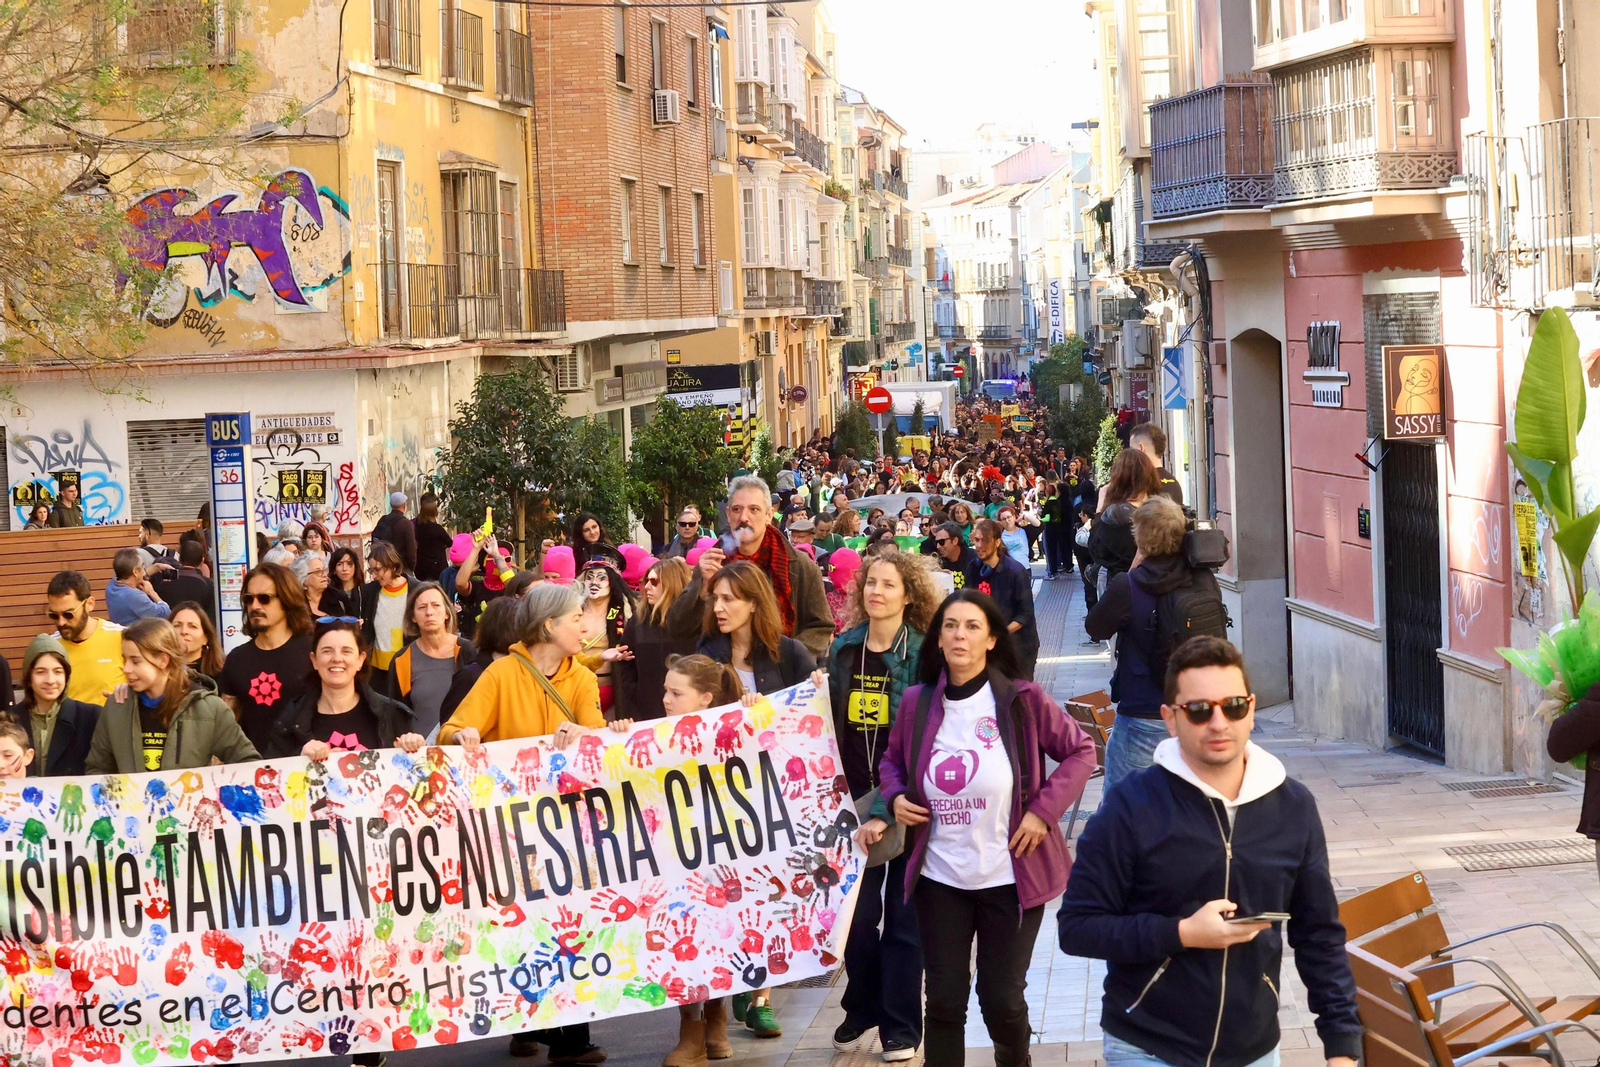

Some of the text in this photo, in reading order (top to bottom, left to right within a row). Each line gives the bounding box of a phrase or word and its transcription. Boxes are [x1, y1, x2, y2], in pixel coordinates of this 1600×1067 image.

[1050, 280, 1060, 327] E-DIFICA
[212, 420, 239, 440] BUS
[261, 416, 332, 428] ANTIGUEDADES
[1395, 415, 1436, 435] SASSY
[256, 436, 266, 444] EL
[220, 469, 239, 484] 36
[929, 798, 986, 811] ERECHO A UN
[939, 811, 971, 825] TECHO
[0, 749, 798, 945] isible TAMBIEN es NUESTRA CASA
[3, 951, 612, 1029] dentes en el Centro Histórico
